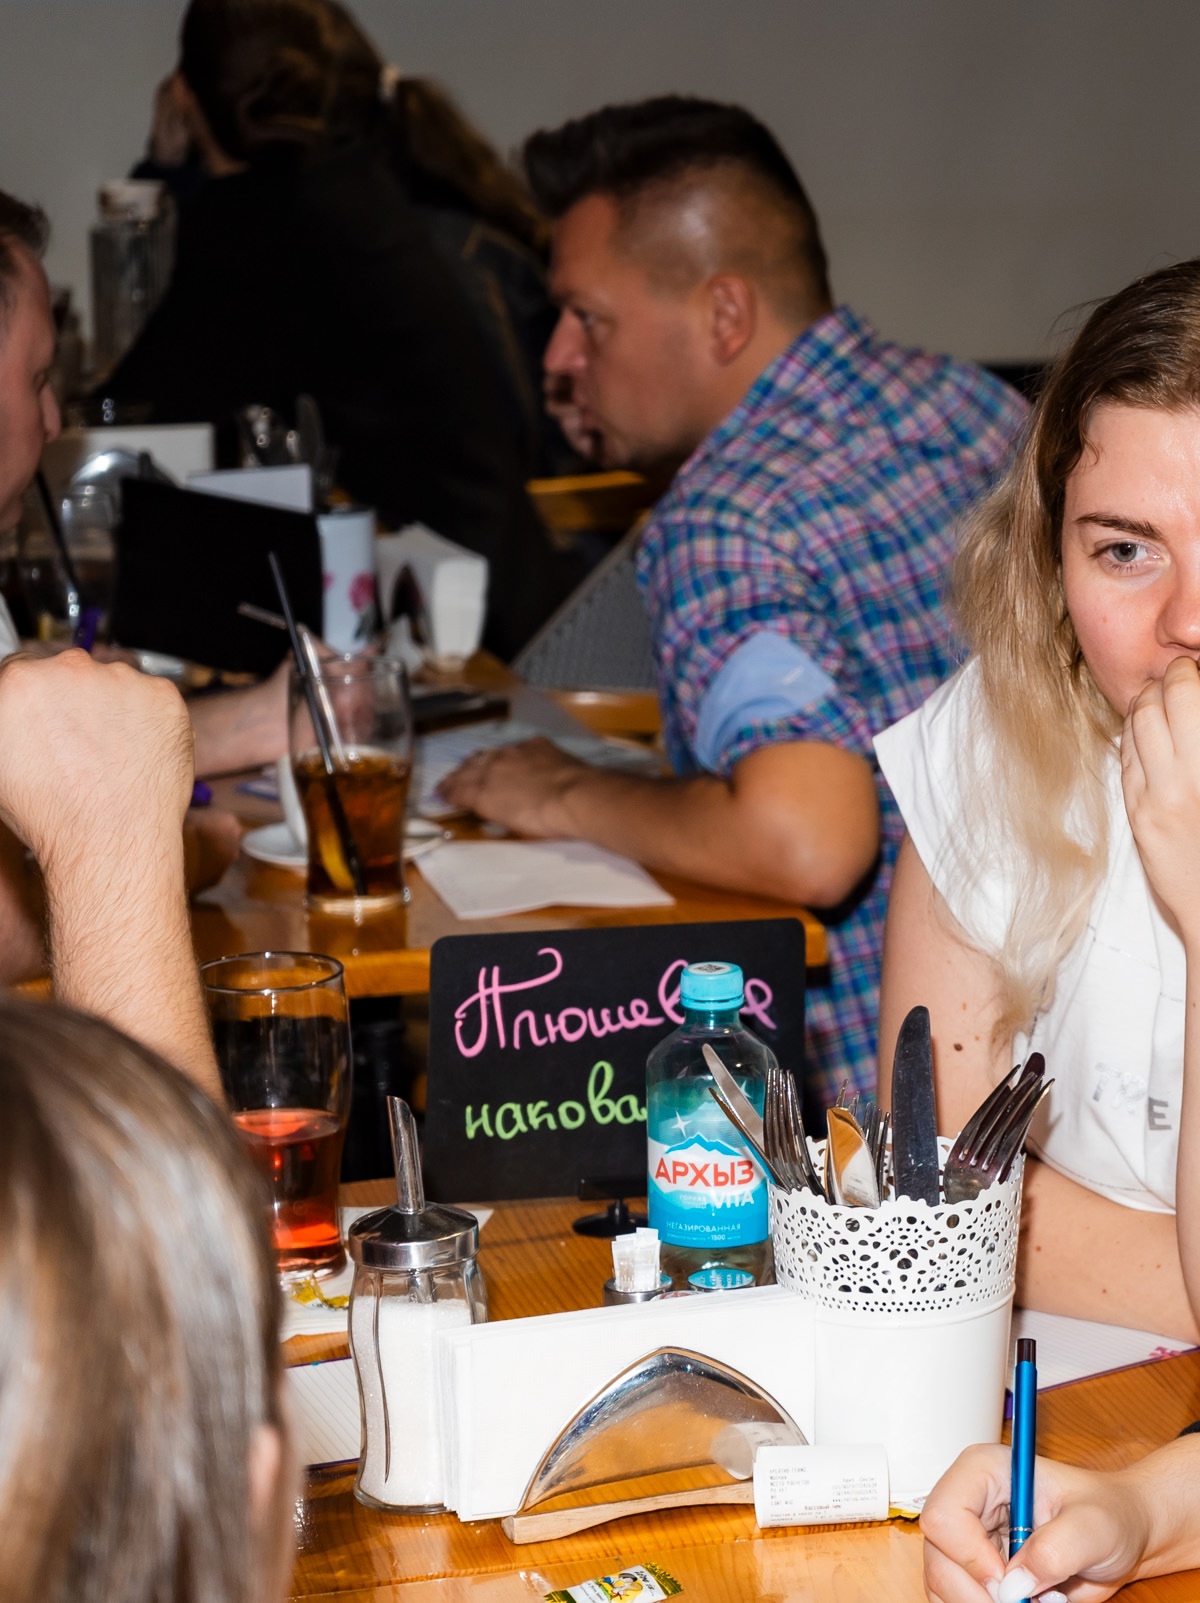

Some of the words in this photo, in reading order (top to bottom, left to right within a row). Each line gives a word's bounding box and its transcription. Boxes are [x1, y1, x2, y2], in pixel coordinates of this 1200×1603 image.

[455, 947, 777, 1058] Плюшеве
[465, 1060, 648, 1140] накова
[655, 1157, 754, 1187] АРХЫЗ
[711, 1189, 755, 1209] VITA
[666, 1221, 741, 1234] НЕГАЗИРОВАННАЯ
